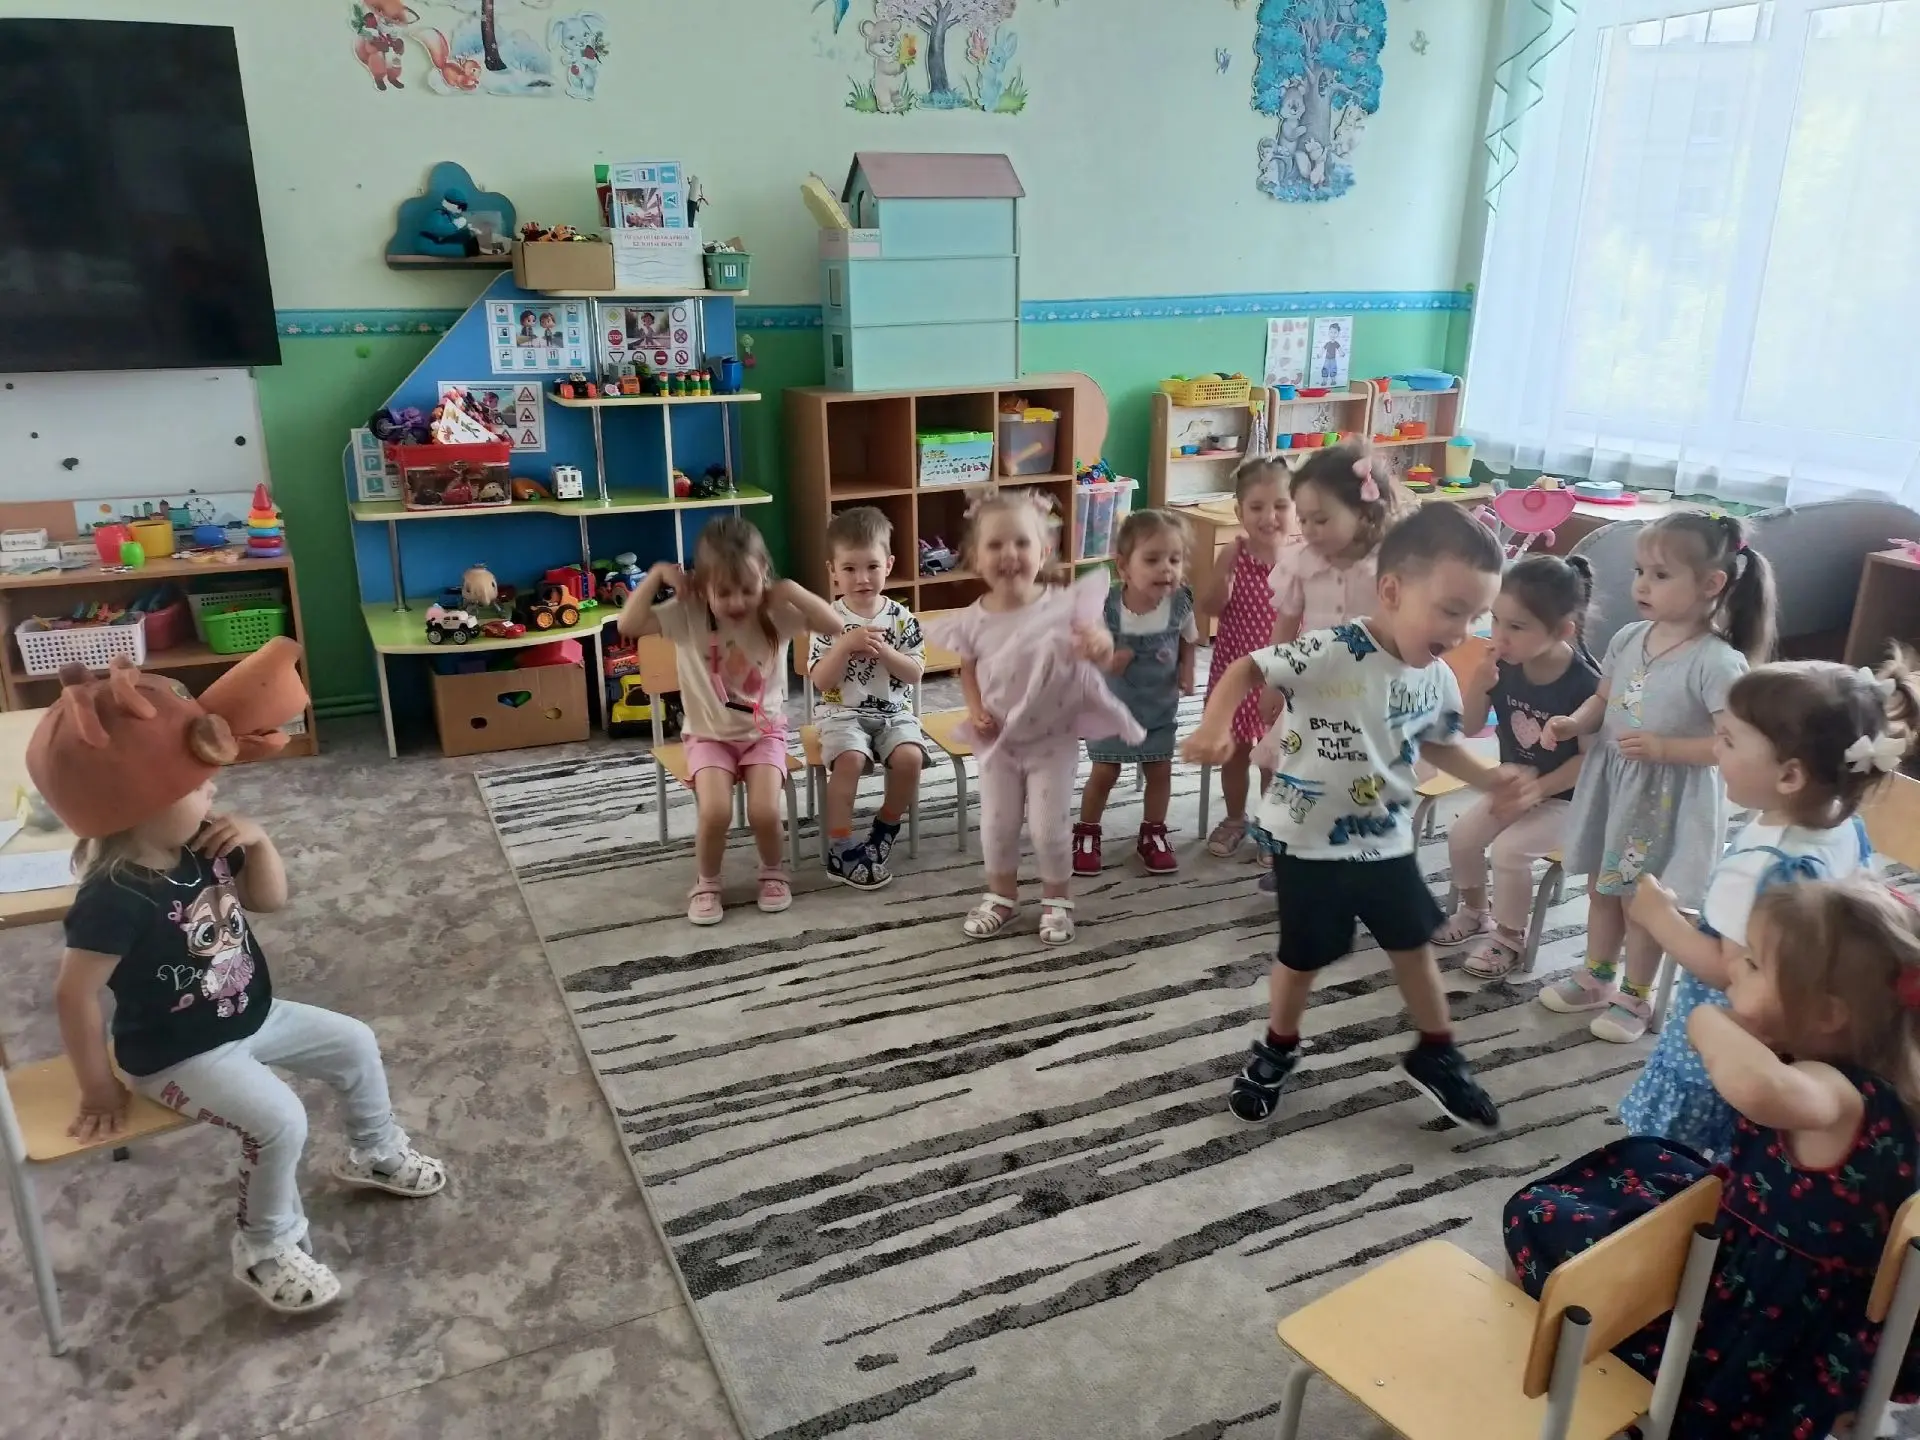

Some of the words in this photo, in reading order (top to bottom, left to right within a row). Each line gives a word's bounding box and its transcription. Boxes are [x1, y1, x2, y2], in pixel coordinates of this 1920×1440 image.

[1506, 694, 1530, 711] love
[1309, 717, 1363, 734] BREAK
[1318, 737, 1352, 750] THE
[1317, 748, 1368, 761] RULES
